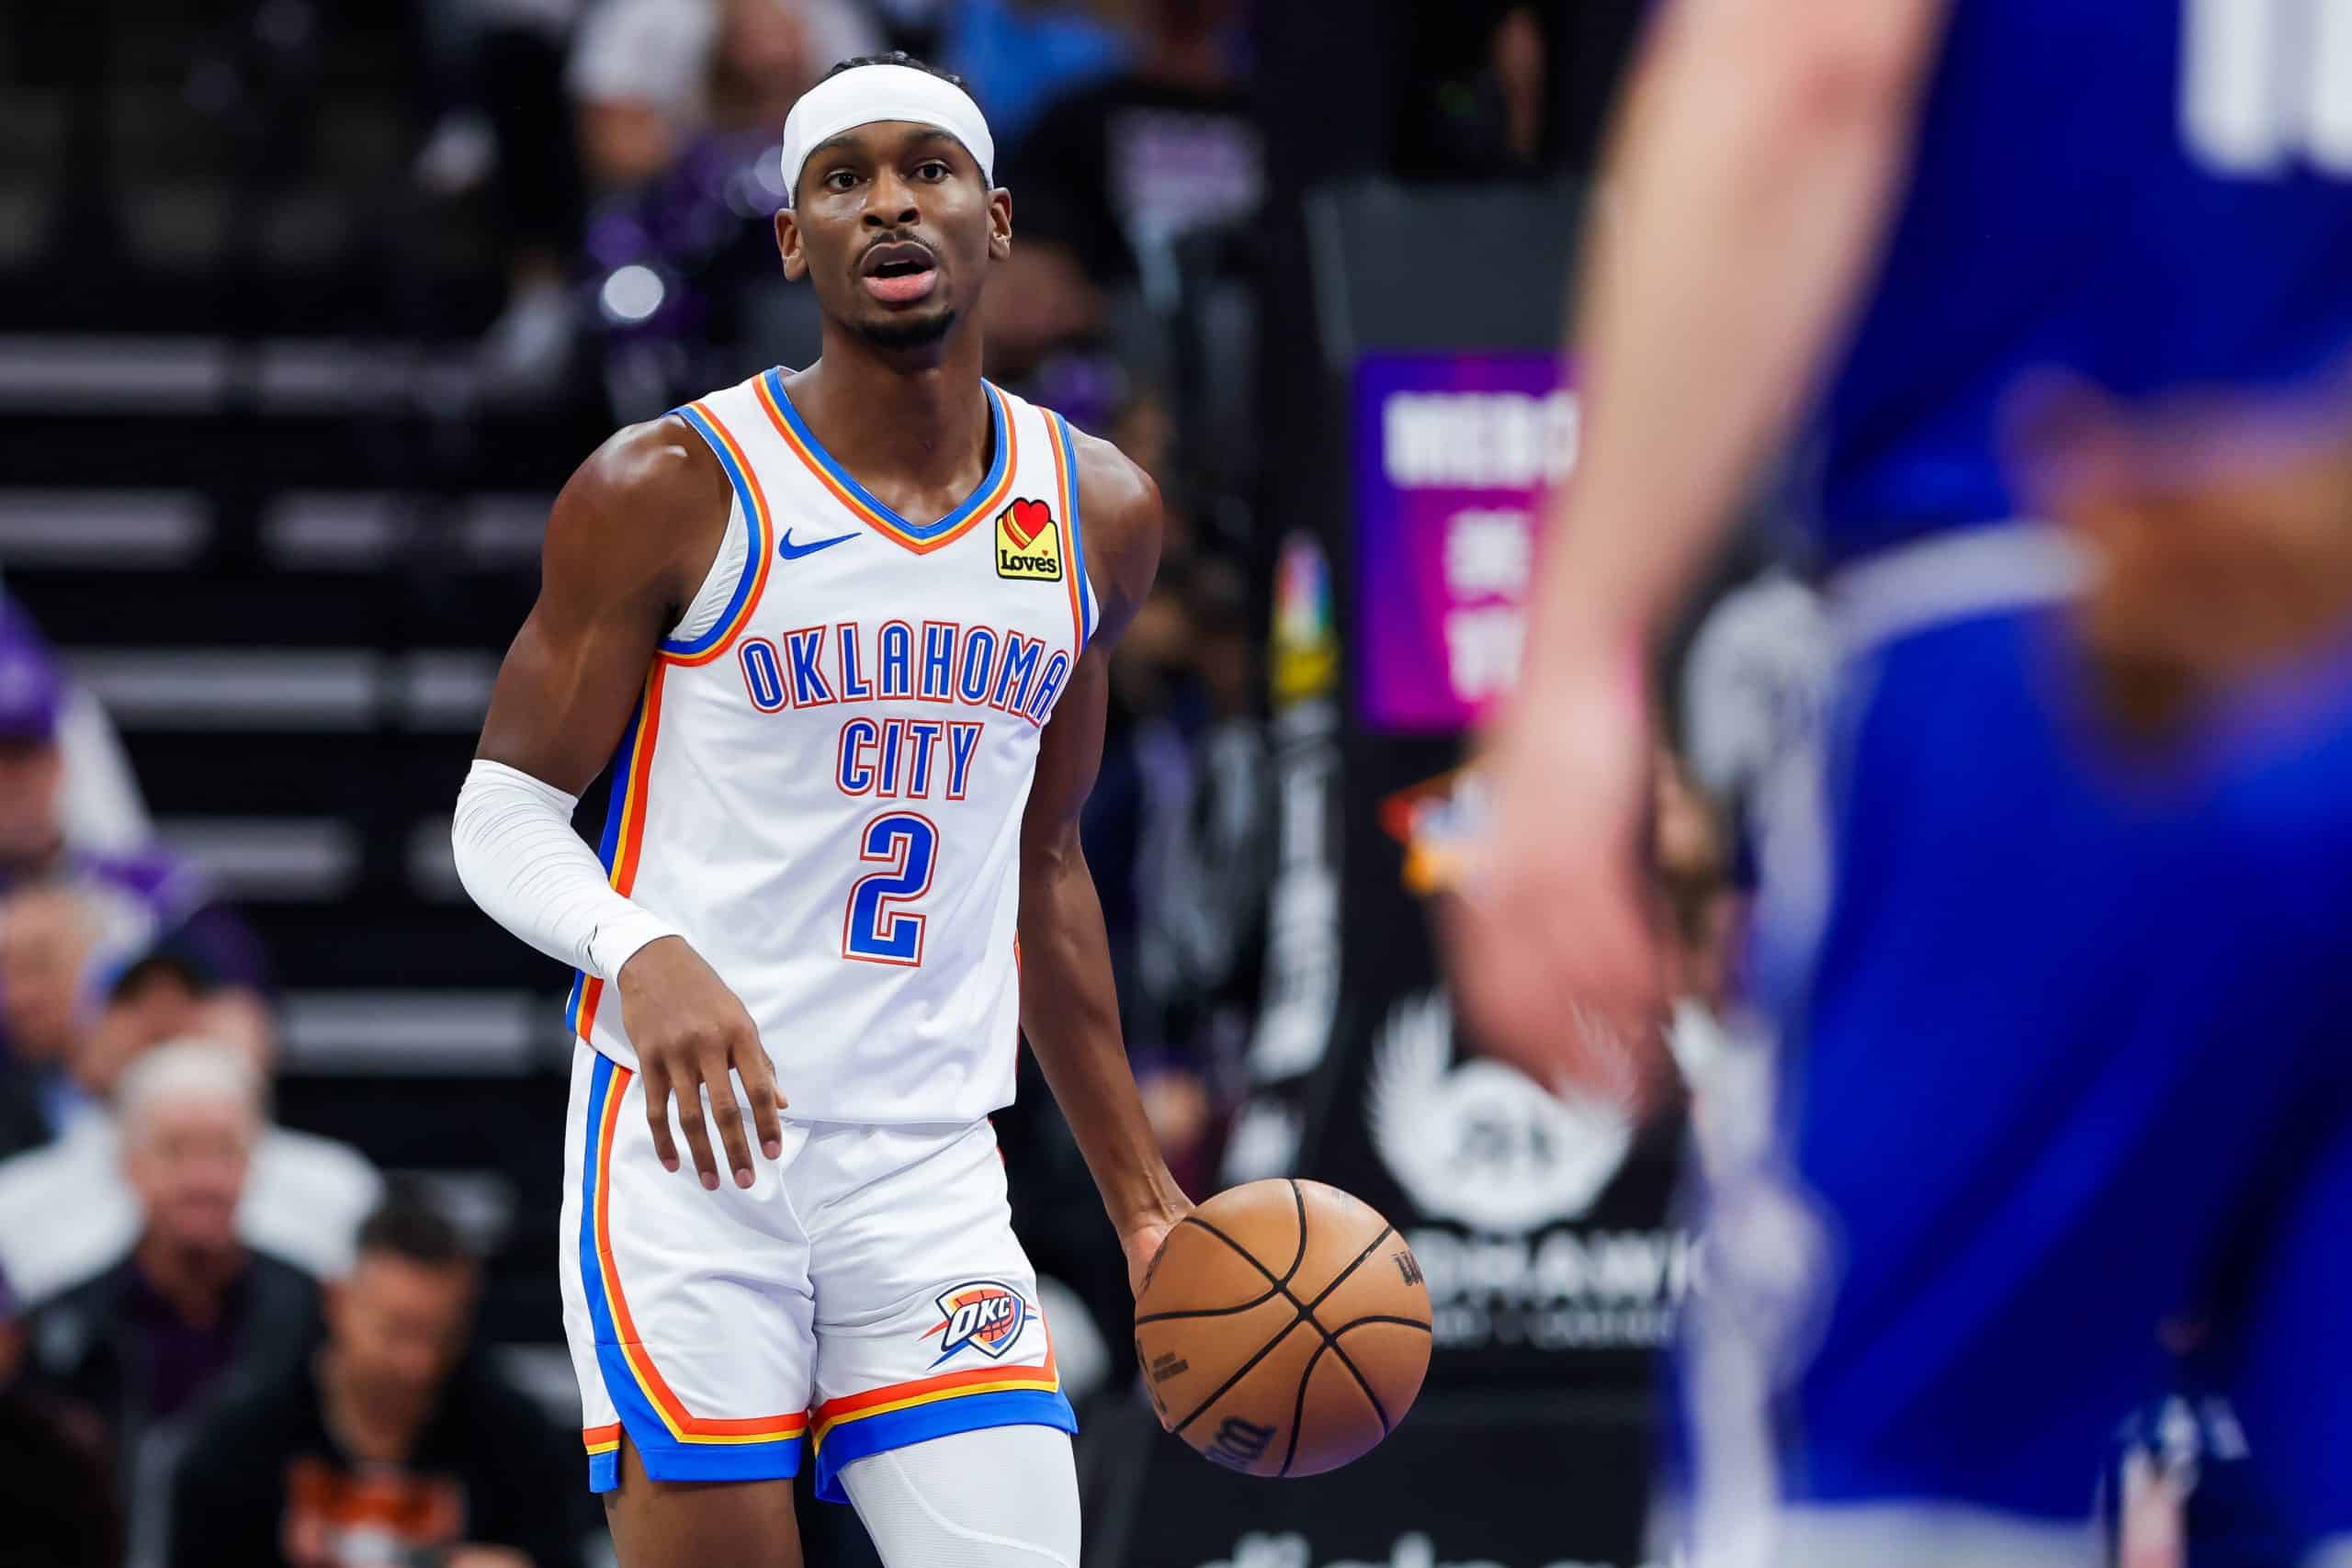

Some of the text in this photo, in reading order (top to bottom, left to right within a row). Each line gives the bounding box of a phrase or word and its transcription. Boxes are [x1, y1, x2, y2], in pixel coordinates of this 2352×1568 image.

[738, 619, 1069, 728] OKLAHOMA
[836, 716, 984, 801] CITY
[842, 810, 940, 967] 2
[942, 1295, 1012, 1350] OKC
